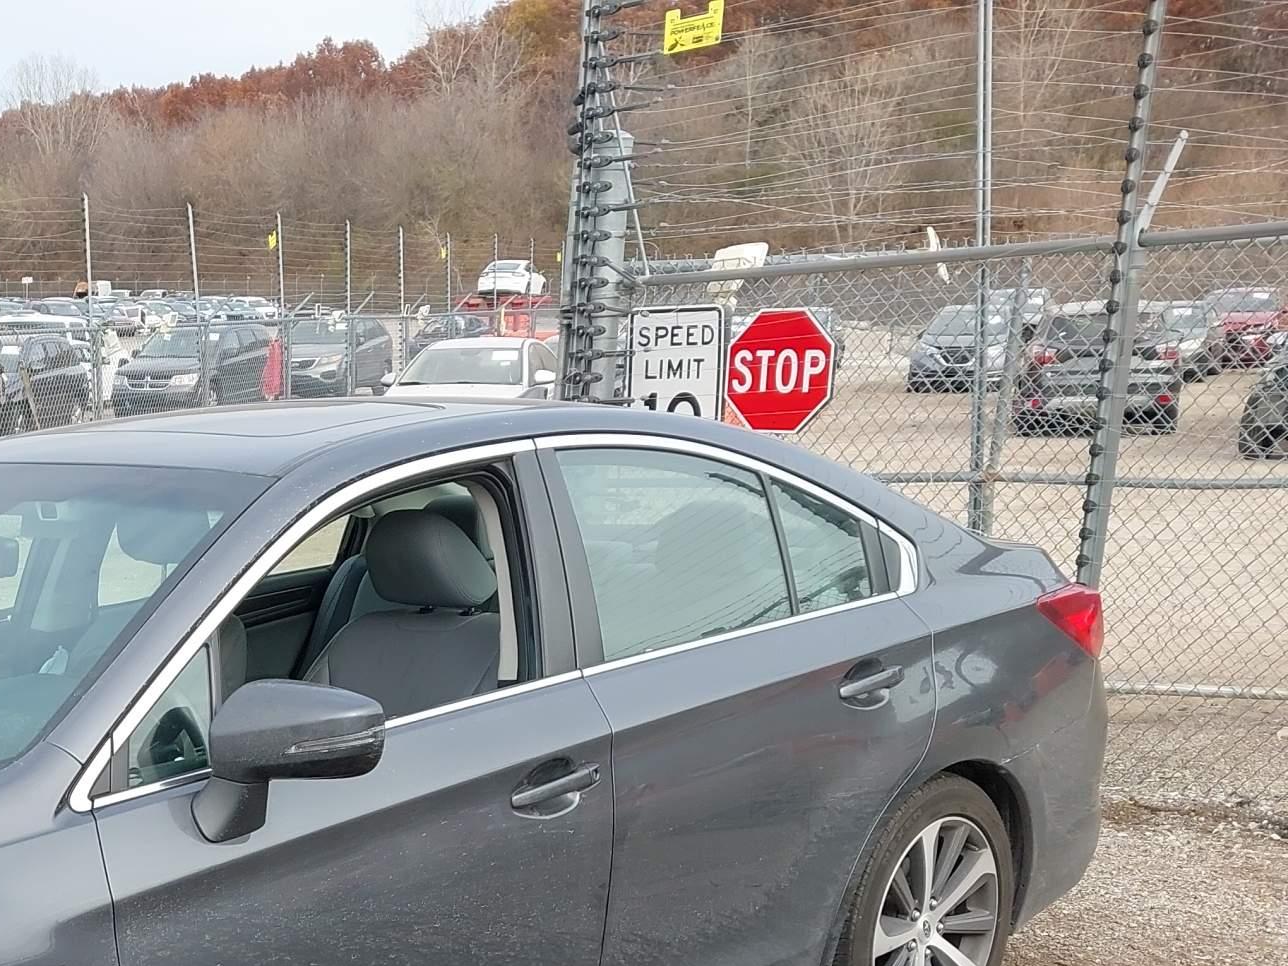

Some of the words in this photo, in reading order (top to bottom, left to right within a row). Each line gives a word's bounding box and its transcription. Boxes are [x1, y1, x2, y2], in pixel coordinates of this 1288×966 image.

[638, 325, 714, 347] SPEED
[644, 358, 705, 379] LIMIT
[731, 348, 826, 394] STOP
